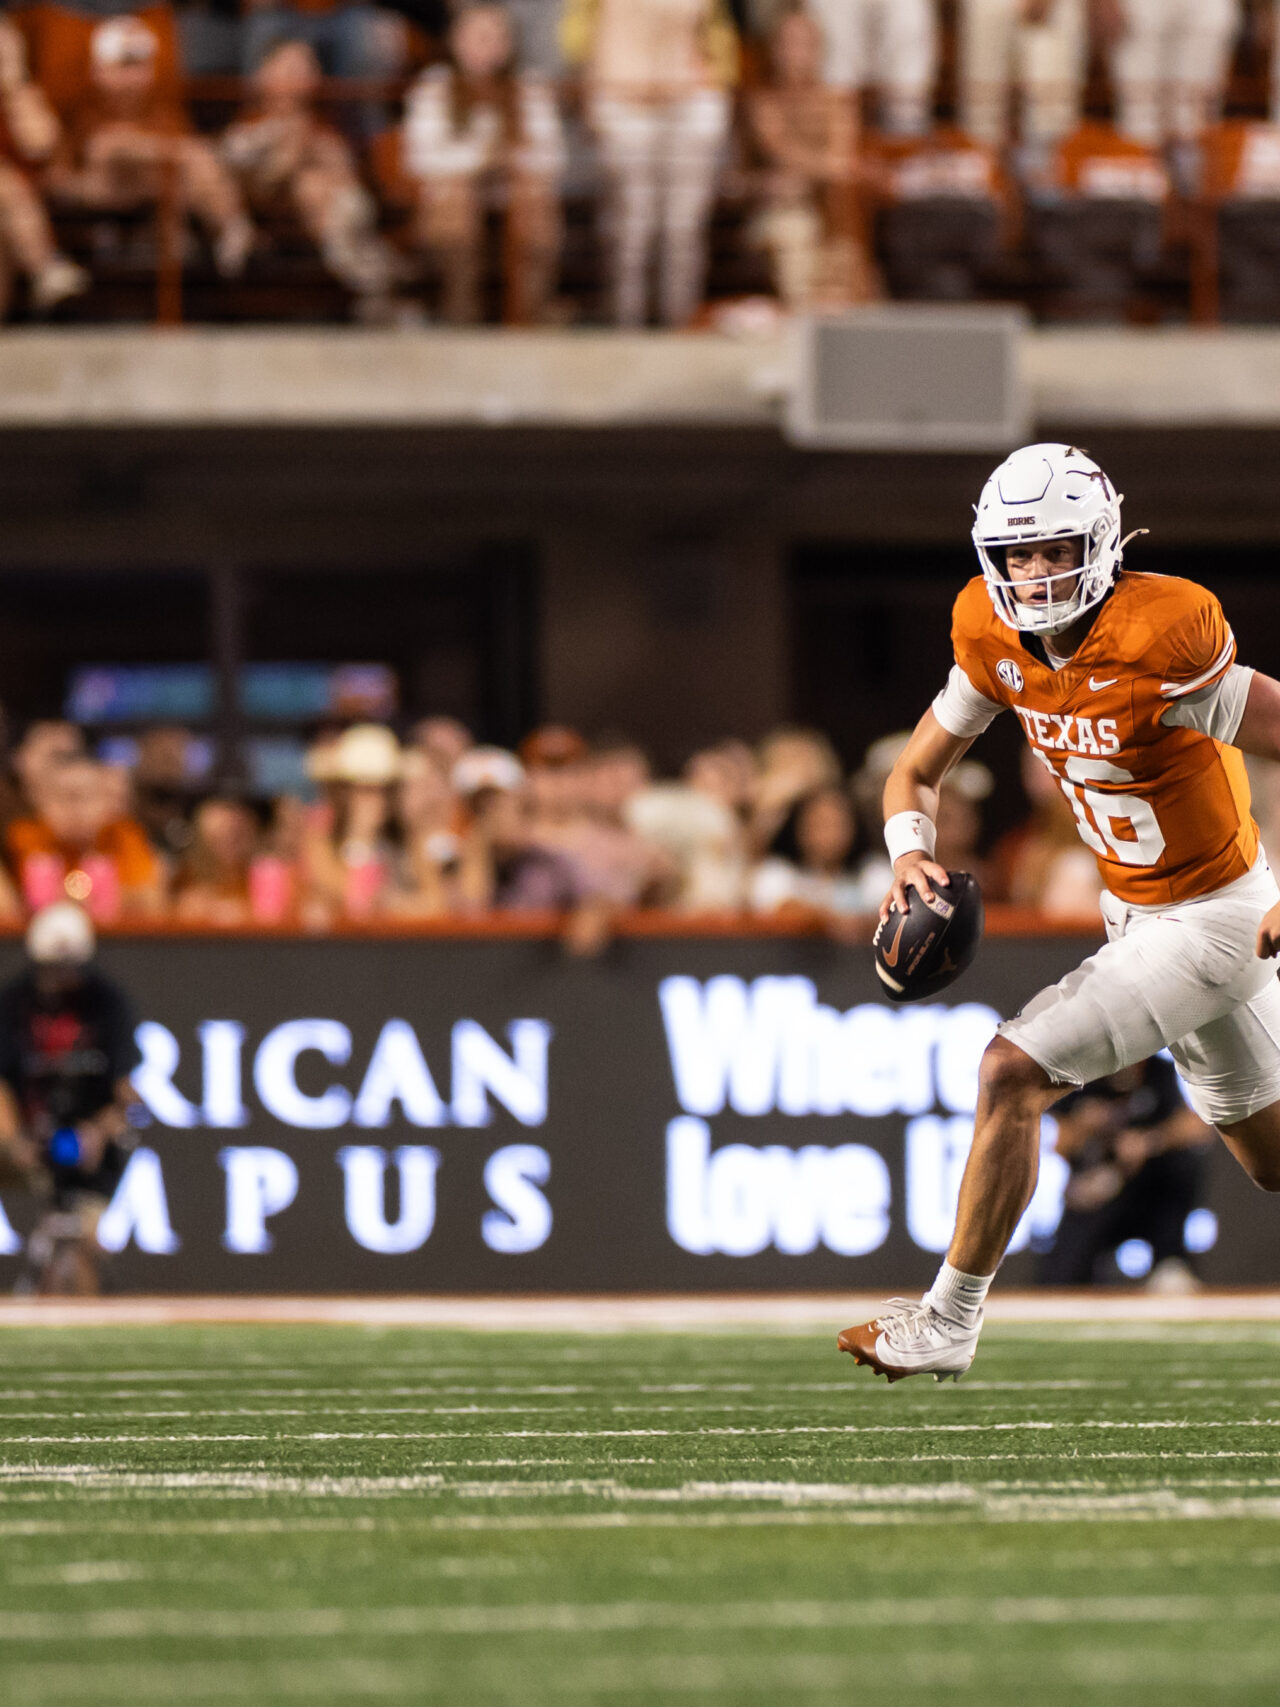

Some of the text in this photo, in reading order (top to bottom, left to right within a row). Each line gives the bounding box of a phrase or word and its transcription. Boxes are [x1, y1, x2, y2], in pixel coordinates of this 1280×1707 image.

[1007, 515, 1036, 527] HORNS
[1013, 704, 1120, 755] TEXAS
[1033, 747, 1166, 866] 16
[665, 1115, 890, 1257] love
